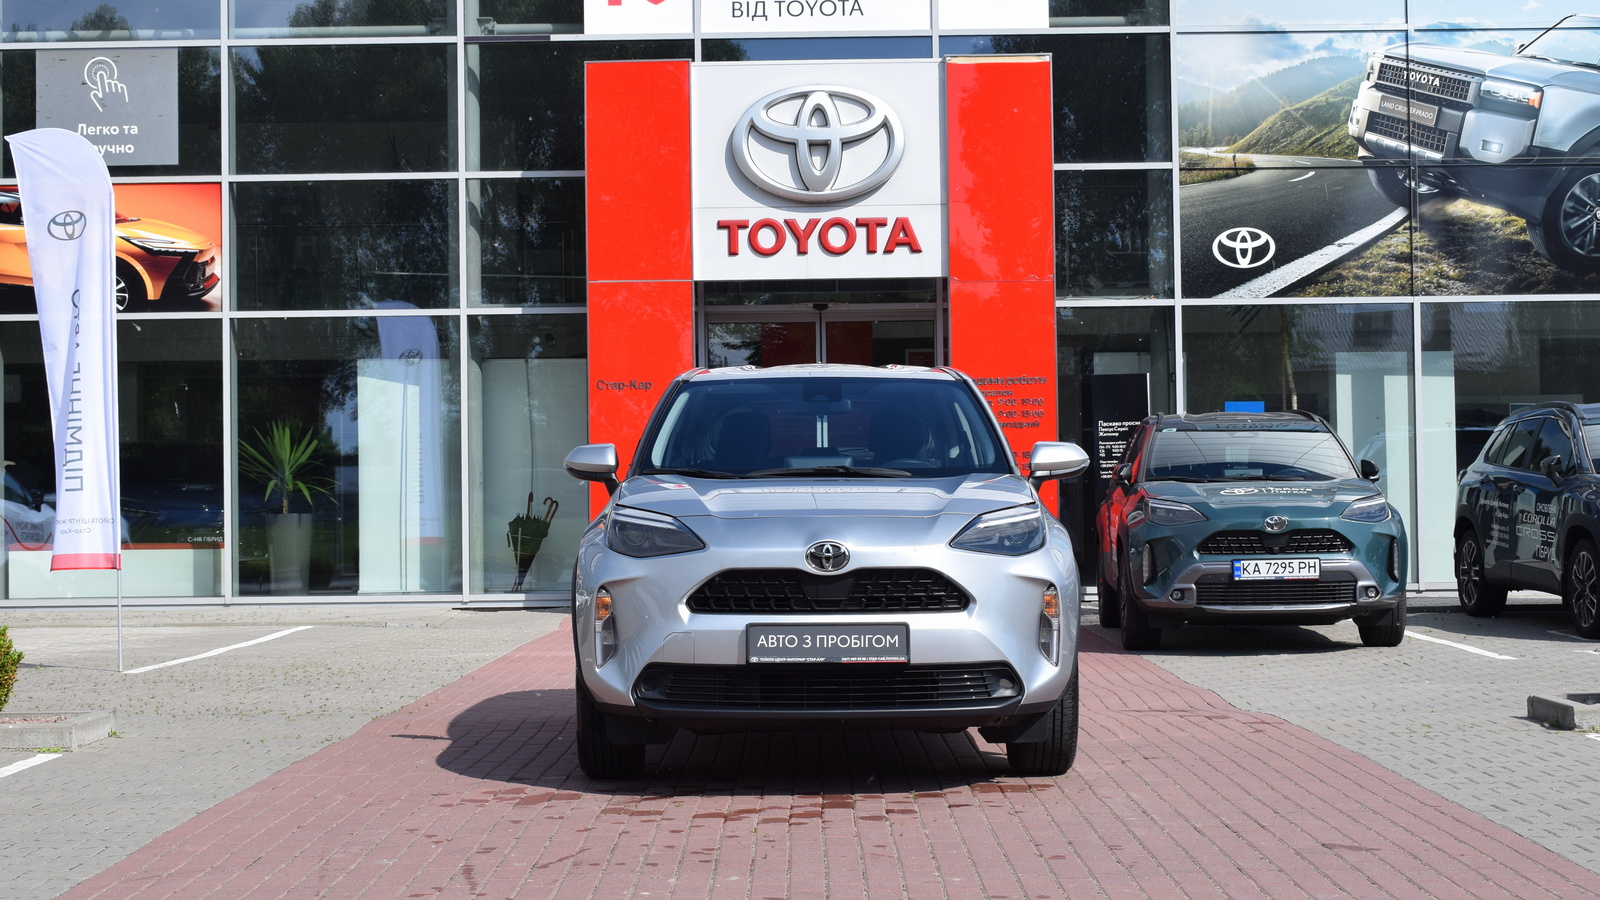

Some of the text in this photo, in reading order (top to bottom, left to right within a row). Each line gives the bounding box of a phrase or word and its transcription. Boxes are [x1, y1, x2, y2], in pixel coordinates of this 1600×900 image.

[731, 0, 864, 21] ВІД TOYOTA
[1403, 71, 1440, 87] TOYOTA
[1381, 101, 1394, 110] LAND
[1416, 108, 1434, 119] PRADO
[77, 123, 138, 136] Легко та
[94, 144, 135, 157] учно
[716, 217, 923, 257] TOYOTA
[596, 379, 653, 392] Стар-Кар
[972, 374, 1047, 387] дини роботи
[980, 389, 1014, 397] осалон
[1522, 512, 1556, 526] COROLLA
[1515, 525, 1556, 542] CROSS
[1242, 561, 1317, 575] KA 7295 PH
[756, 634, 899, 648] АВТО З ПРОБІГОМ
